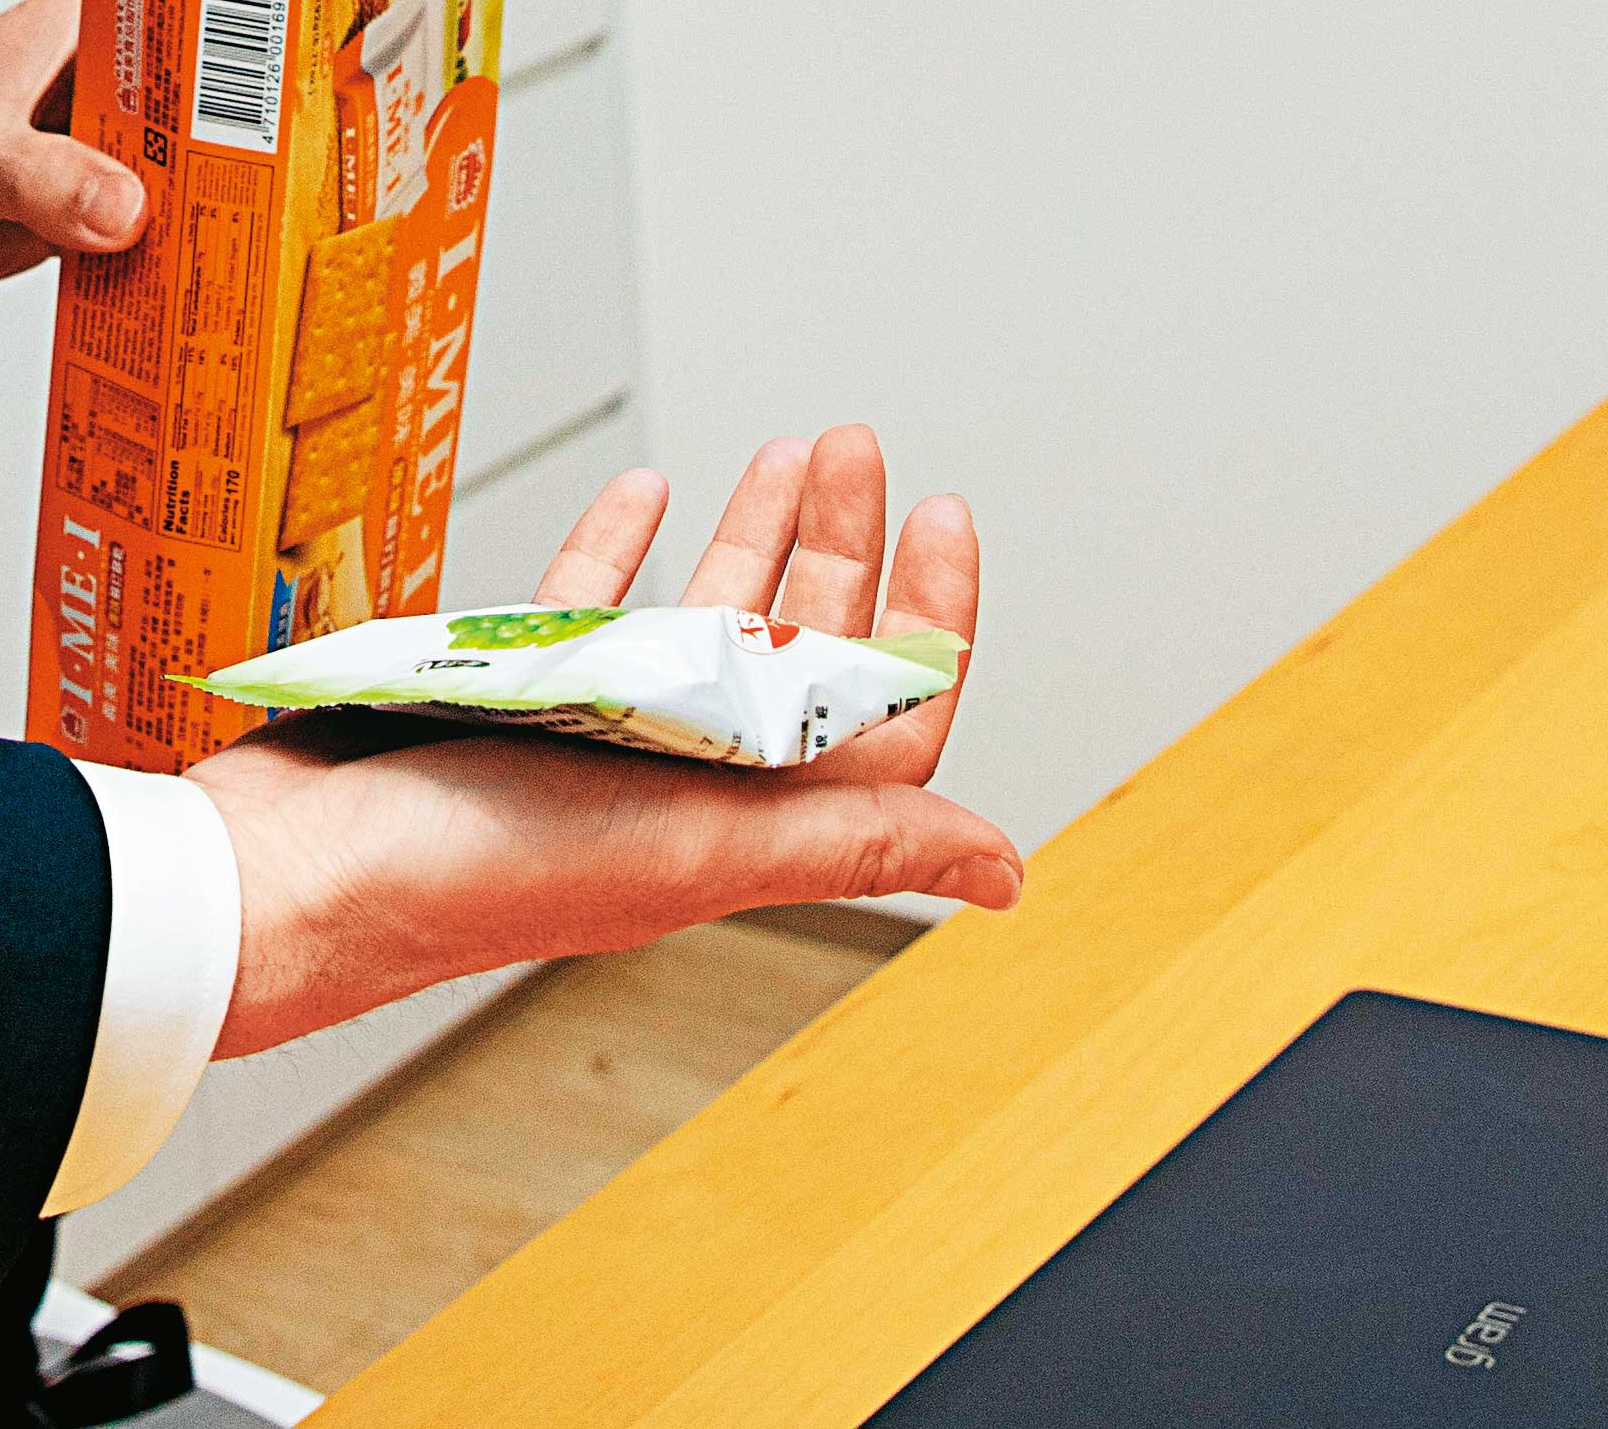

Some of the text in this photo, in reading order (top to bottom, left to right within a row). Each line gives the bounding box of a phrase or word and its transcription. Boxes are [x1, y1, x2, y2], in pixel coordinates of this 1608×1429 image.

[163, 459, 180, 533] Nutrition
[226, 469, 240, 495] 170
[176, 489, 191, 535] Facts
[218, 496, 231, 543] Calories
[1444, 1300, 1528, 1368] gram
